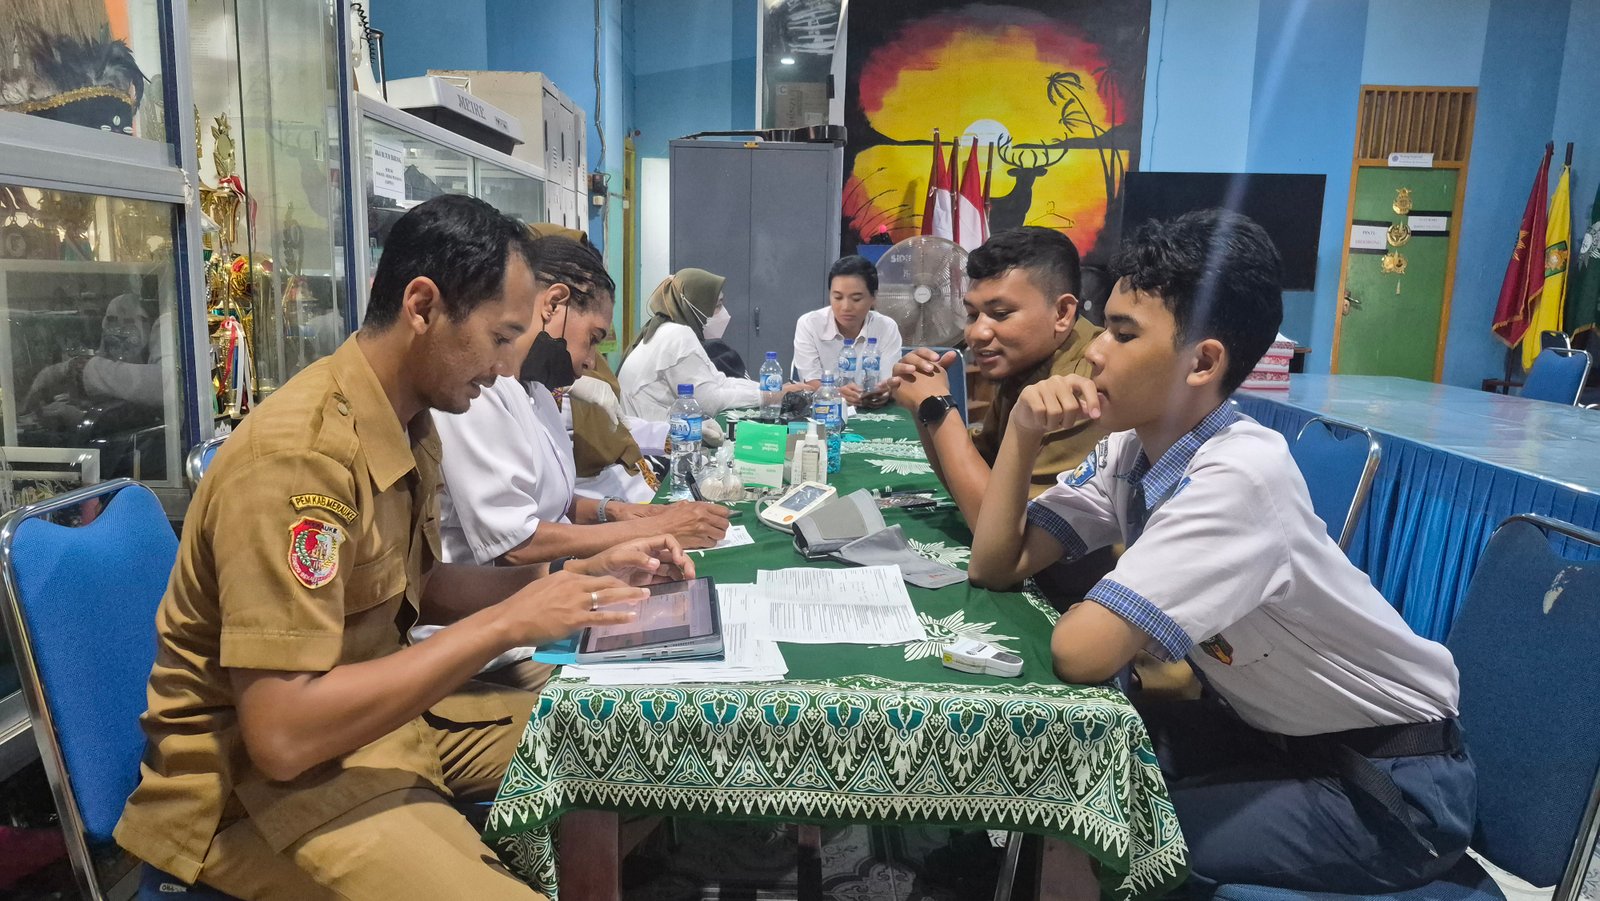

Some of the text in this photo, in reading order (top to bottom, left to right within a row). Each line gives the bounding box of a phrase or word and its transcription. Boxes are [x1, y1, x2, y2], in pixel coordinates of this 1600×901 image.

[295, 496, 356, 521] PEM KAB MERAUKE
